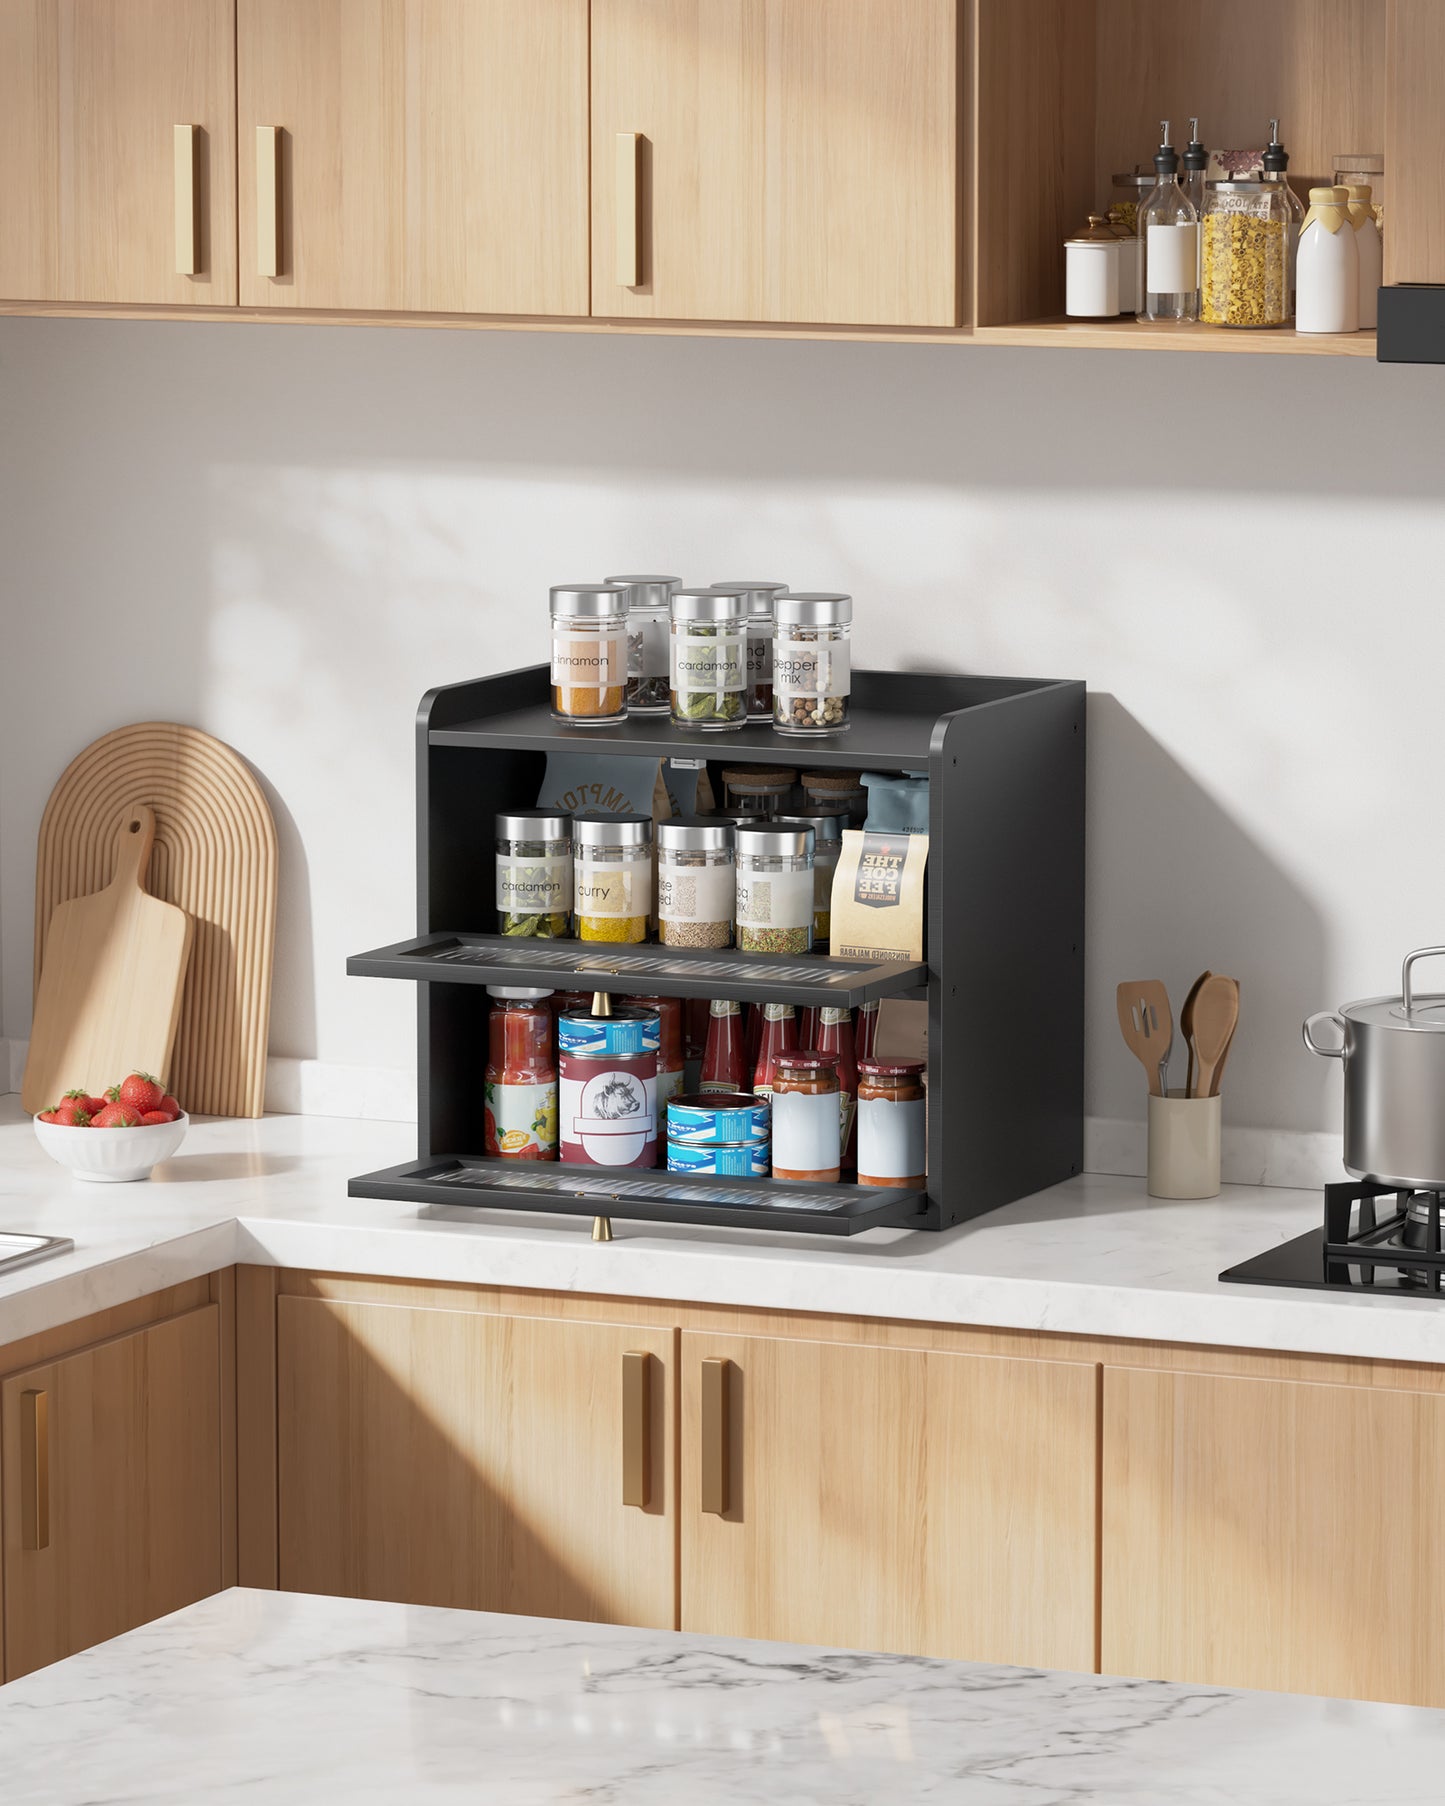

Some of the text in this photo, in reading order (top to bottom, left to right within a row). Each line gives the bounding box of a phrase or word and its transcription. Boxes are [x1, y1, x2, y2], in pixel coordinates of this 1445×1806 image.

[552, 654, 609, 666] cinnamon
[679, 660, 737, 671] cardamon
[773, 659, 819, 674] pepper
[781, 673, 801, 684] mix
[502, 882, 560, 892] cardamon
[579, 886, 610, 900] curry
